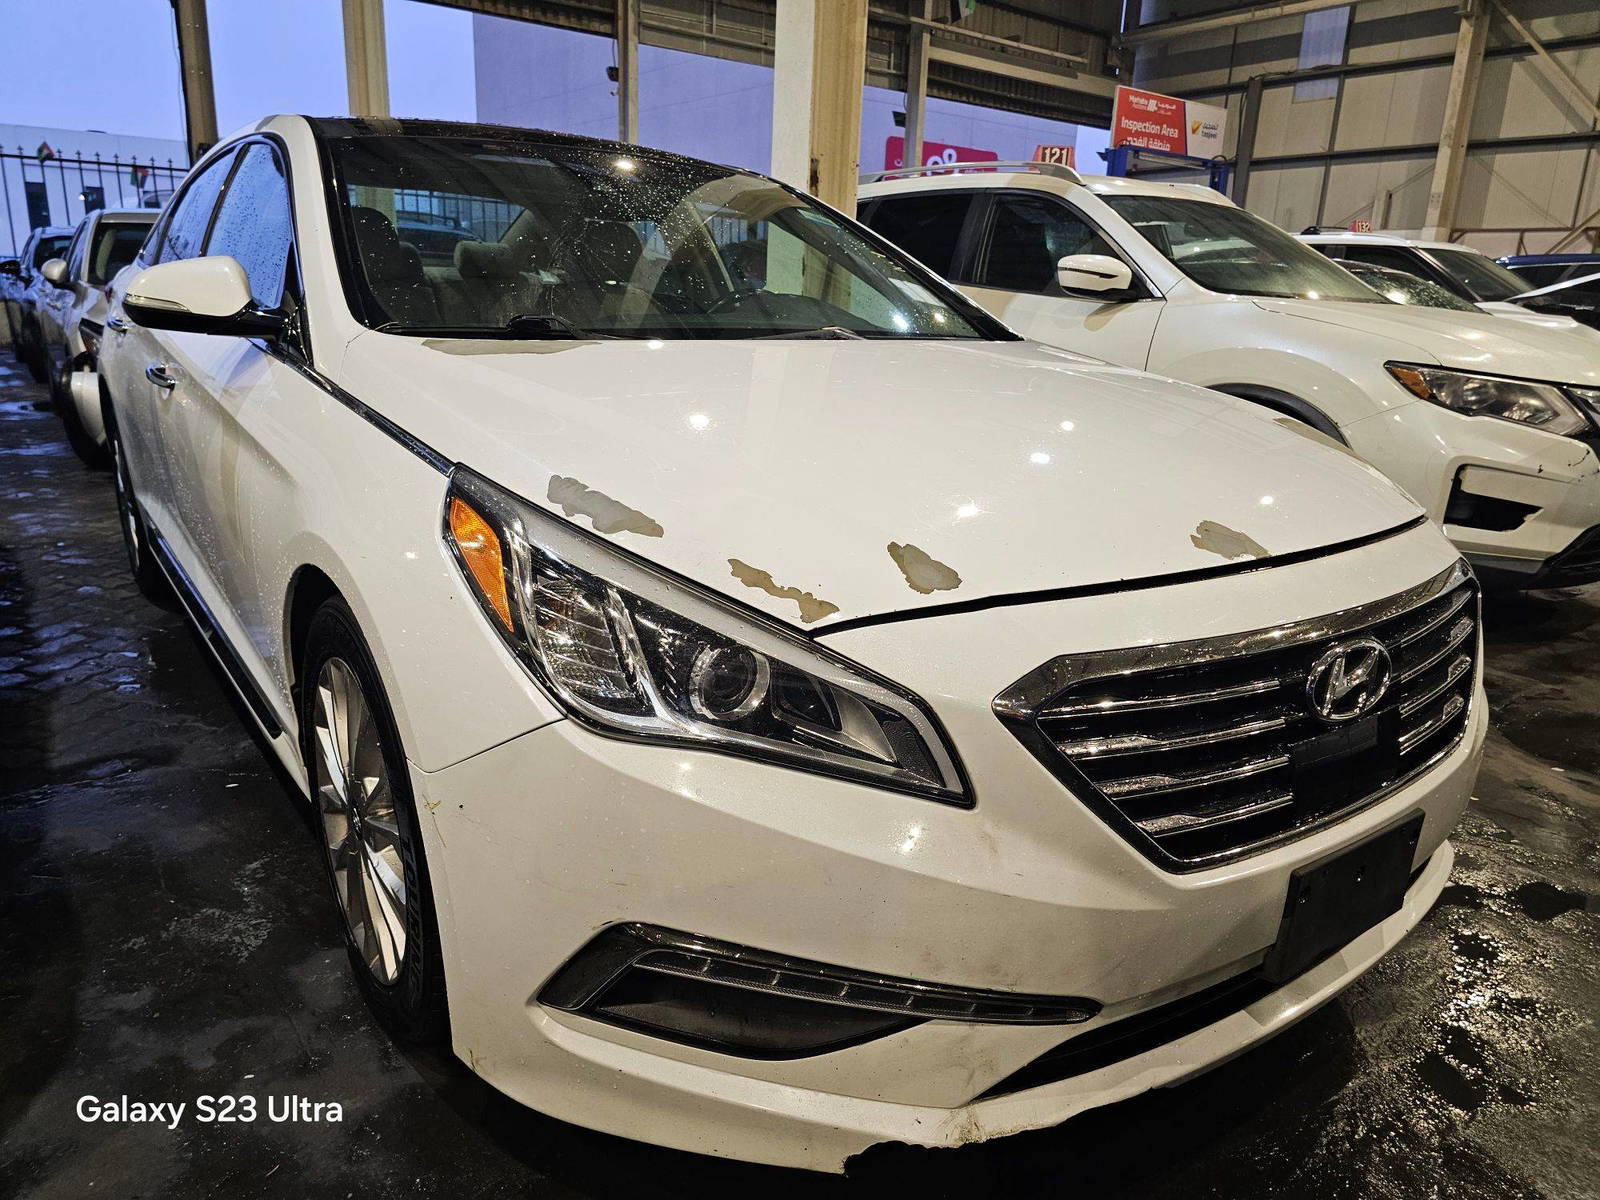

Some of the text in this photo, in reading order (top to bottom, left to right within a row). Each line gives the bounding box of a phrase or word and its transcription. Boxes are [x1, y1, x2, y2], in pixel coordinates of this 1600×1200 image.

[1121, 116, 1178, 138] Inspection Area
[1044, 147, 1068, 166] 121
